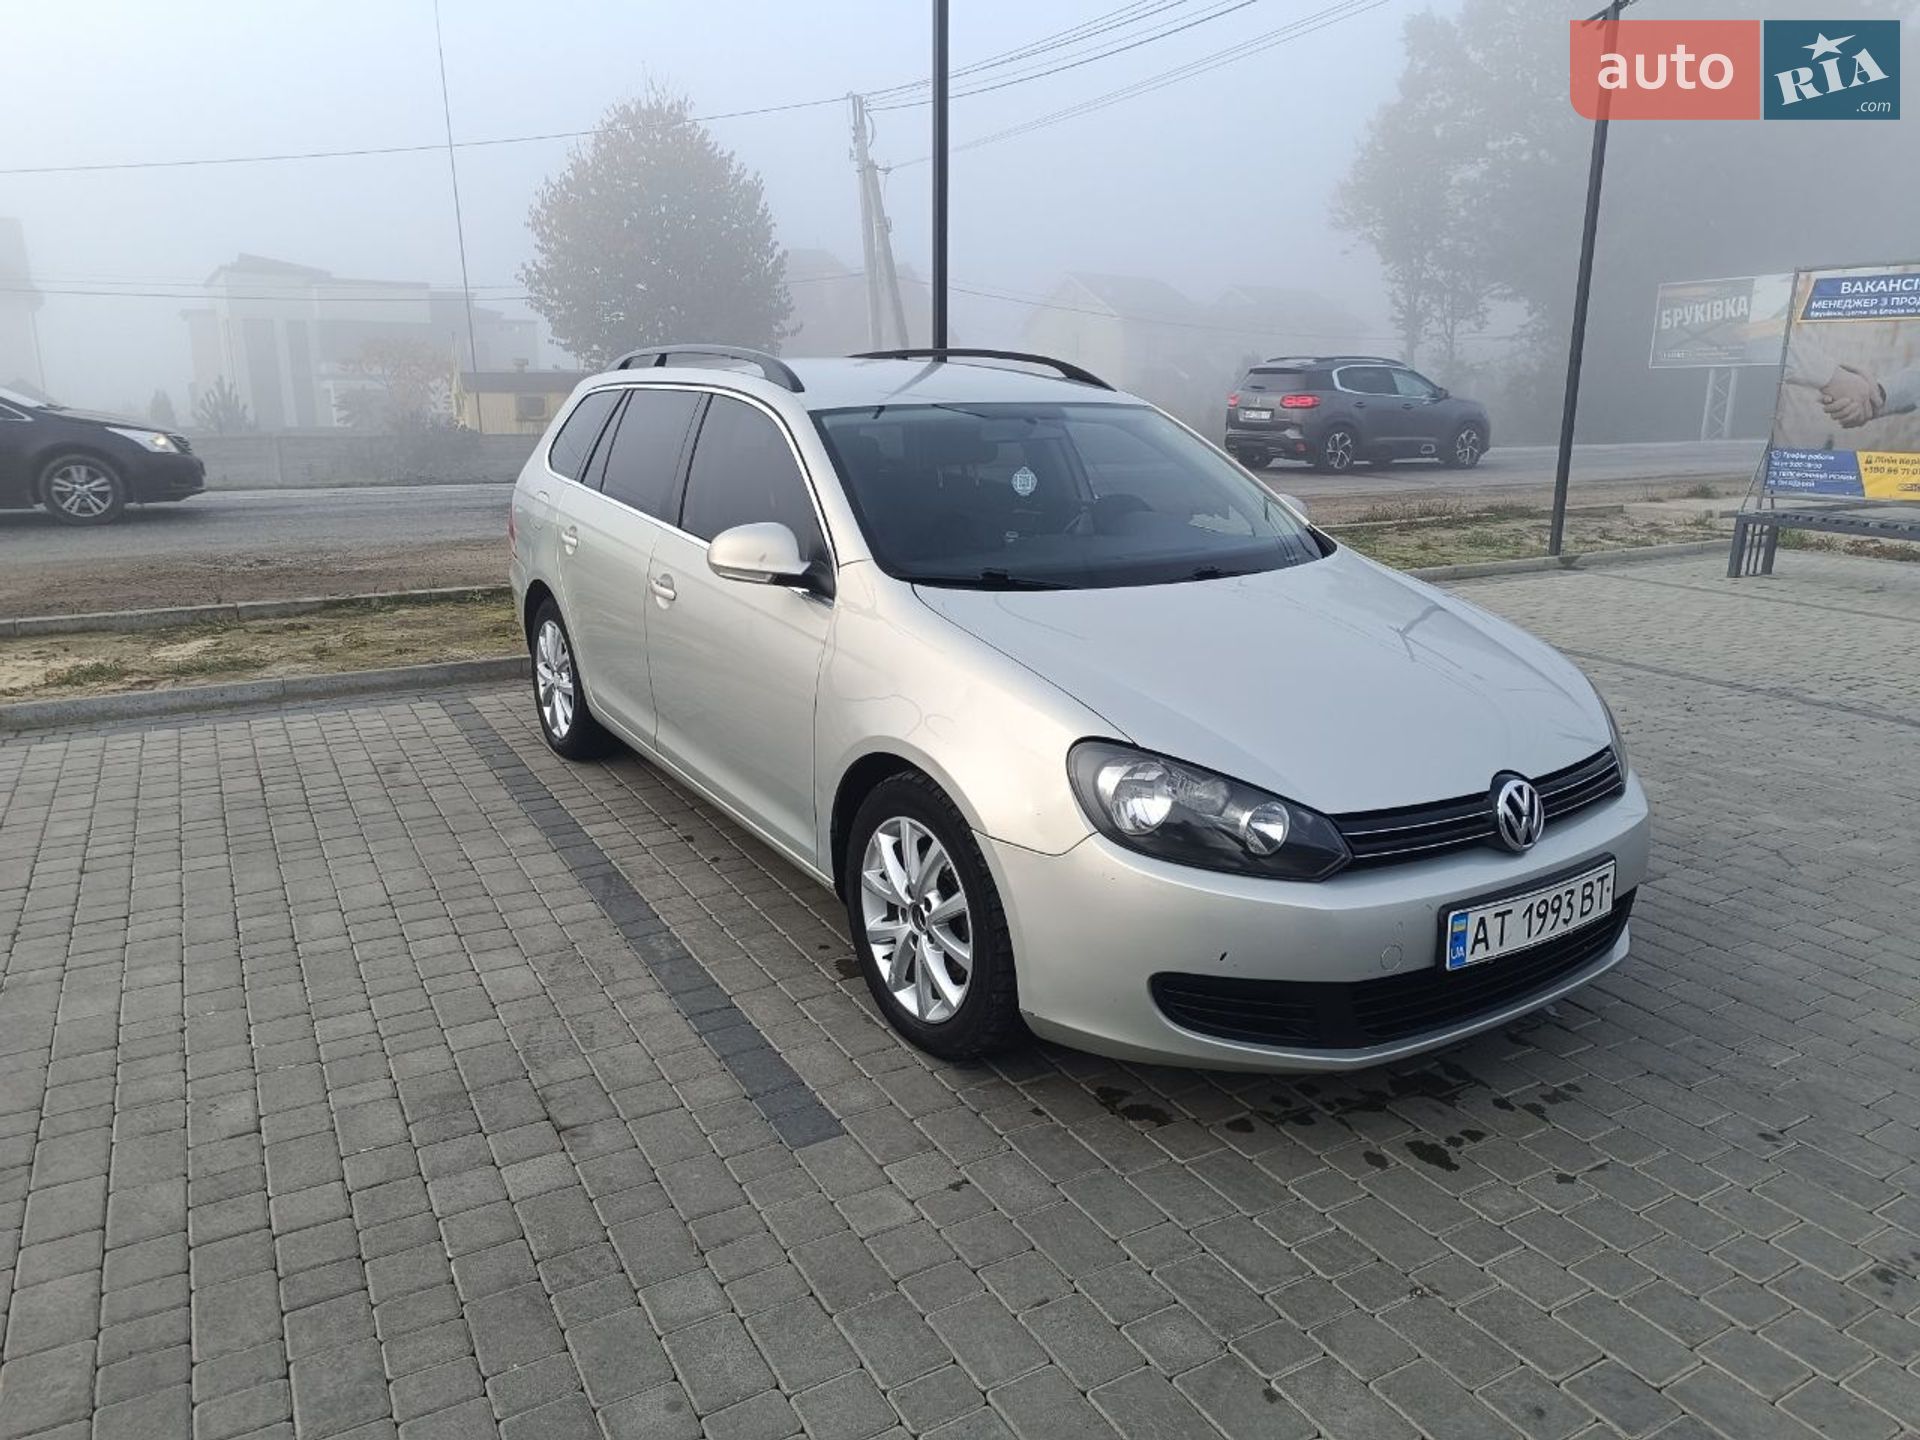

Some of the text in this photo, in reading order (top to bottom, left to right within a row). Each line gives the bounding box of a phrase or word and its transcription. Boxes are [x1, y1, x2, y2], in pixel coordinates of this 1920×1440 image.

[1840, 278, 1920, 294] ВАКАНСІ
[1661, 296, 1749, 329] БРУКІВКА
[1811, 298, 1878, 310] МЕНЕДЖЕР
[1470, 873, 1609, 955] AT 1993 BT
